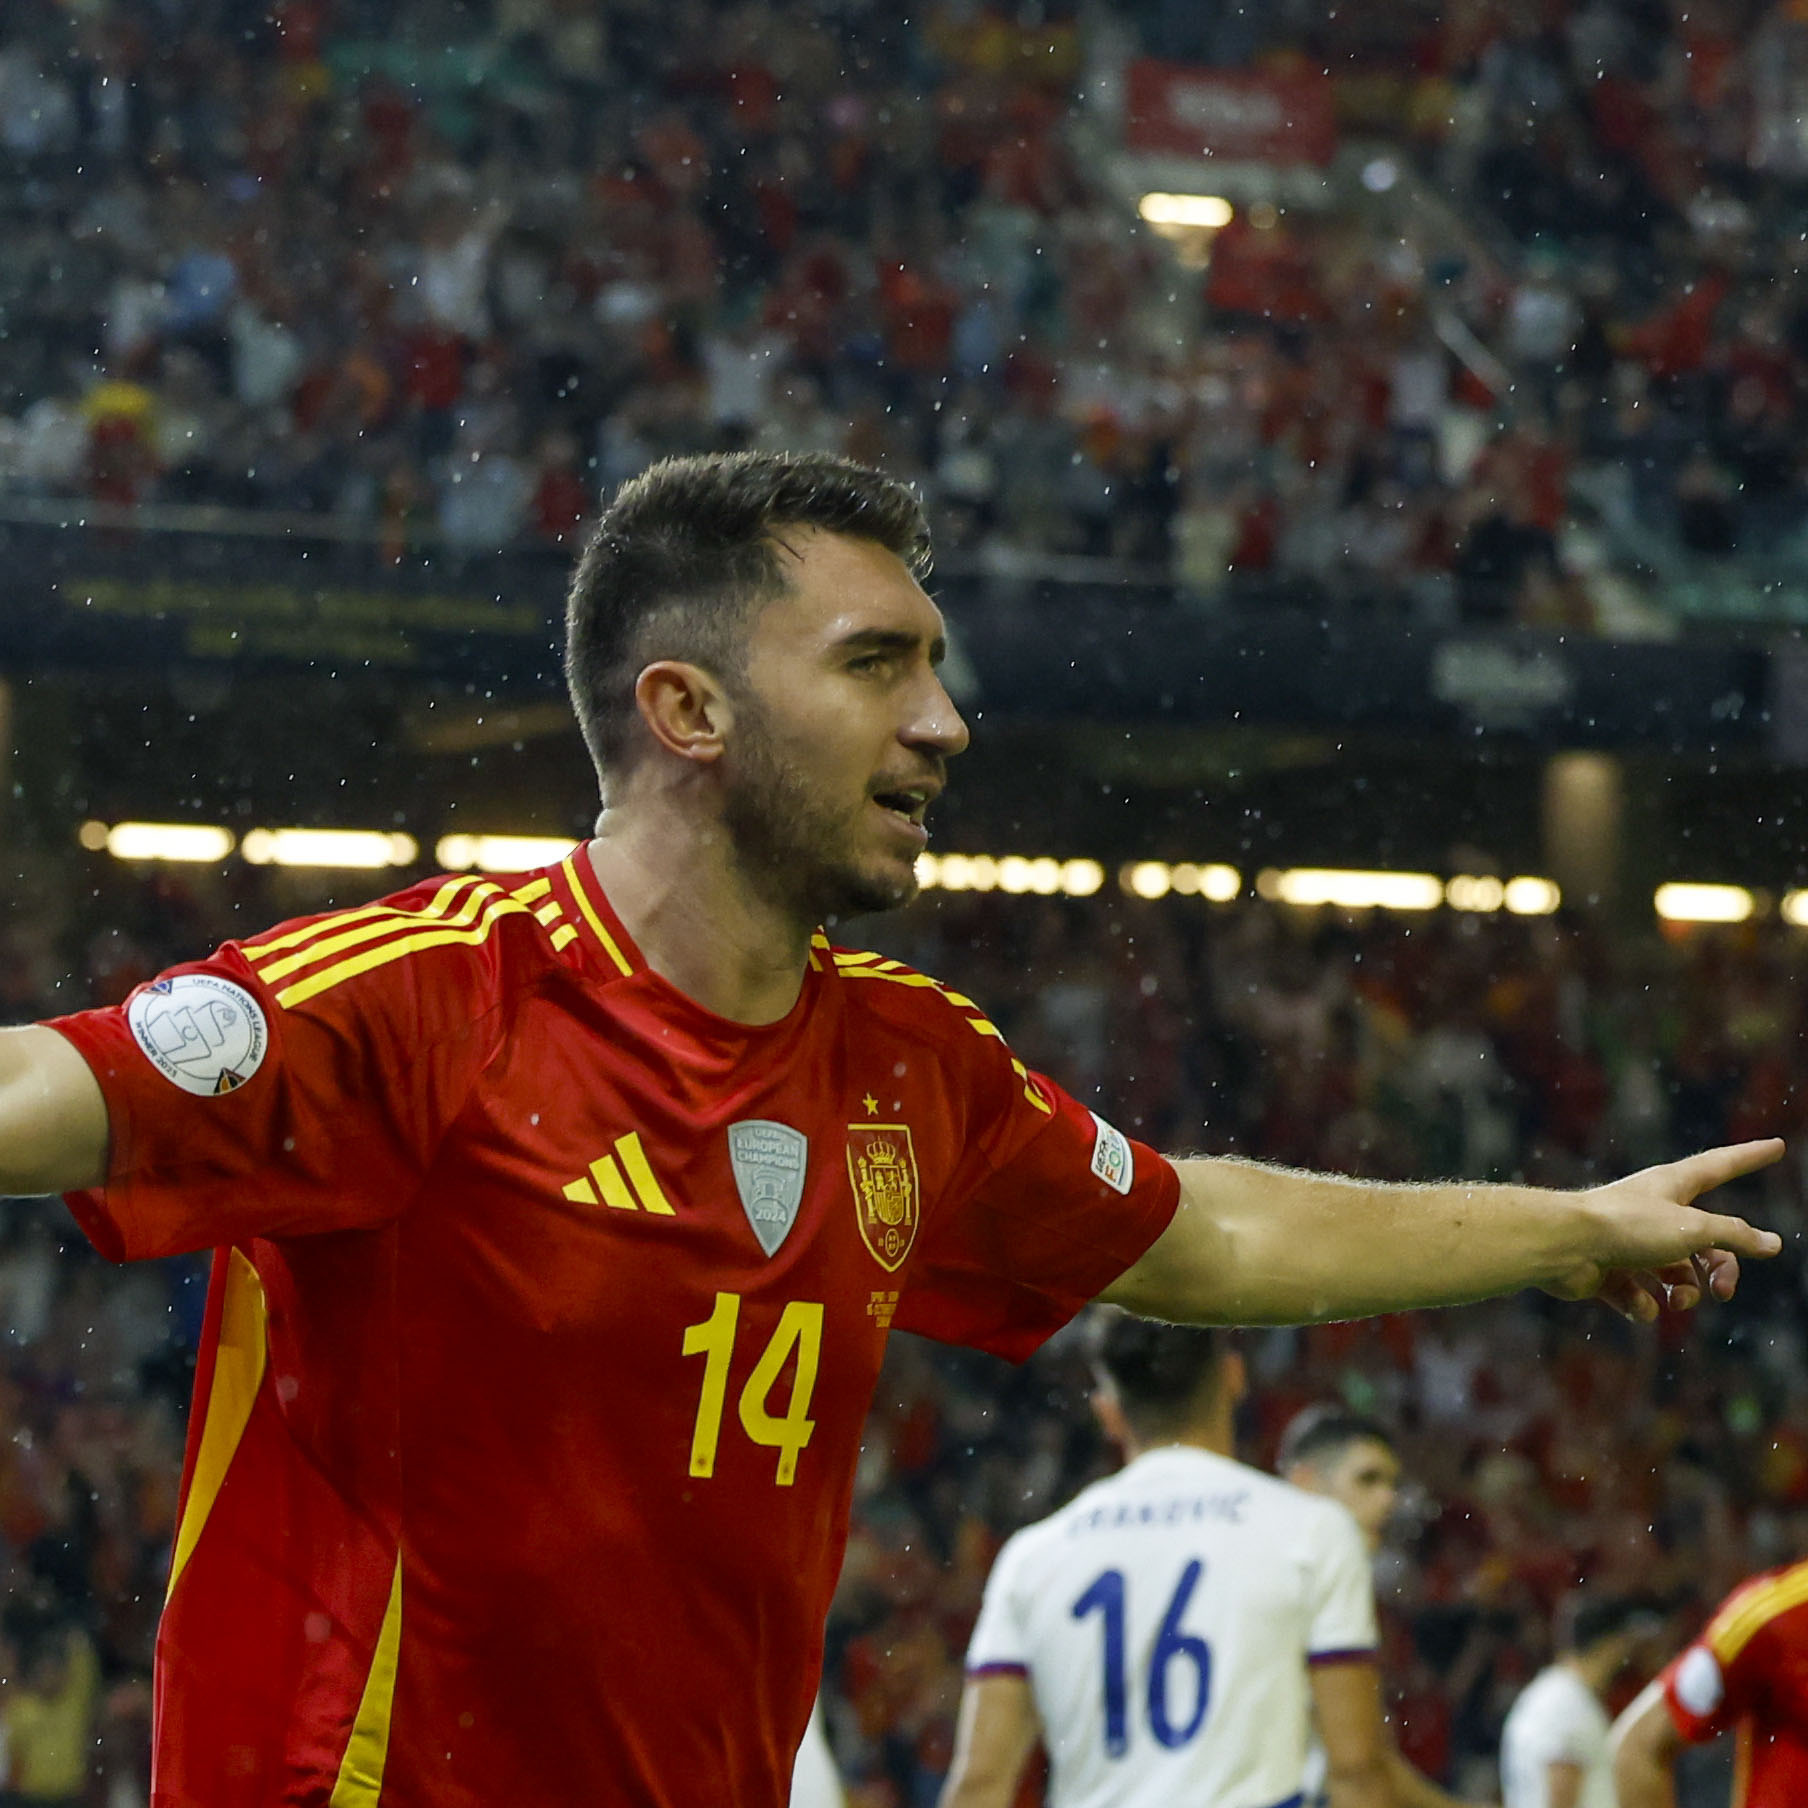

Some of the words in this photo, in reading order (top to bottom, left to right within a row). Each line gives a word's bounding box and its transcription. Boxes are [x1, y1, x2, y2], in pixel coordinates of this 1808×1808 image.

[134, 1020, 159, 1059] WINNER
[192, 977, 220, 990] UEFA
[222, 984, 258, 1019] NATIONS
[248, 1018, 264, 1064] LEAGUE
[736, 1138, 799, 1158] EUROPEAN
[755, 1209, 786, 1222] 2024
[681, 1292, 825, 1487] 14
[1070, 1557, 1213, 1758] 16
